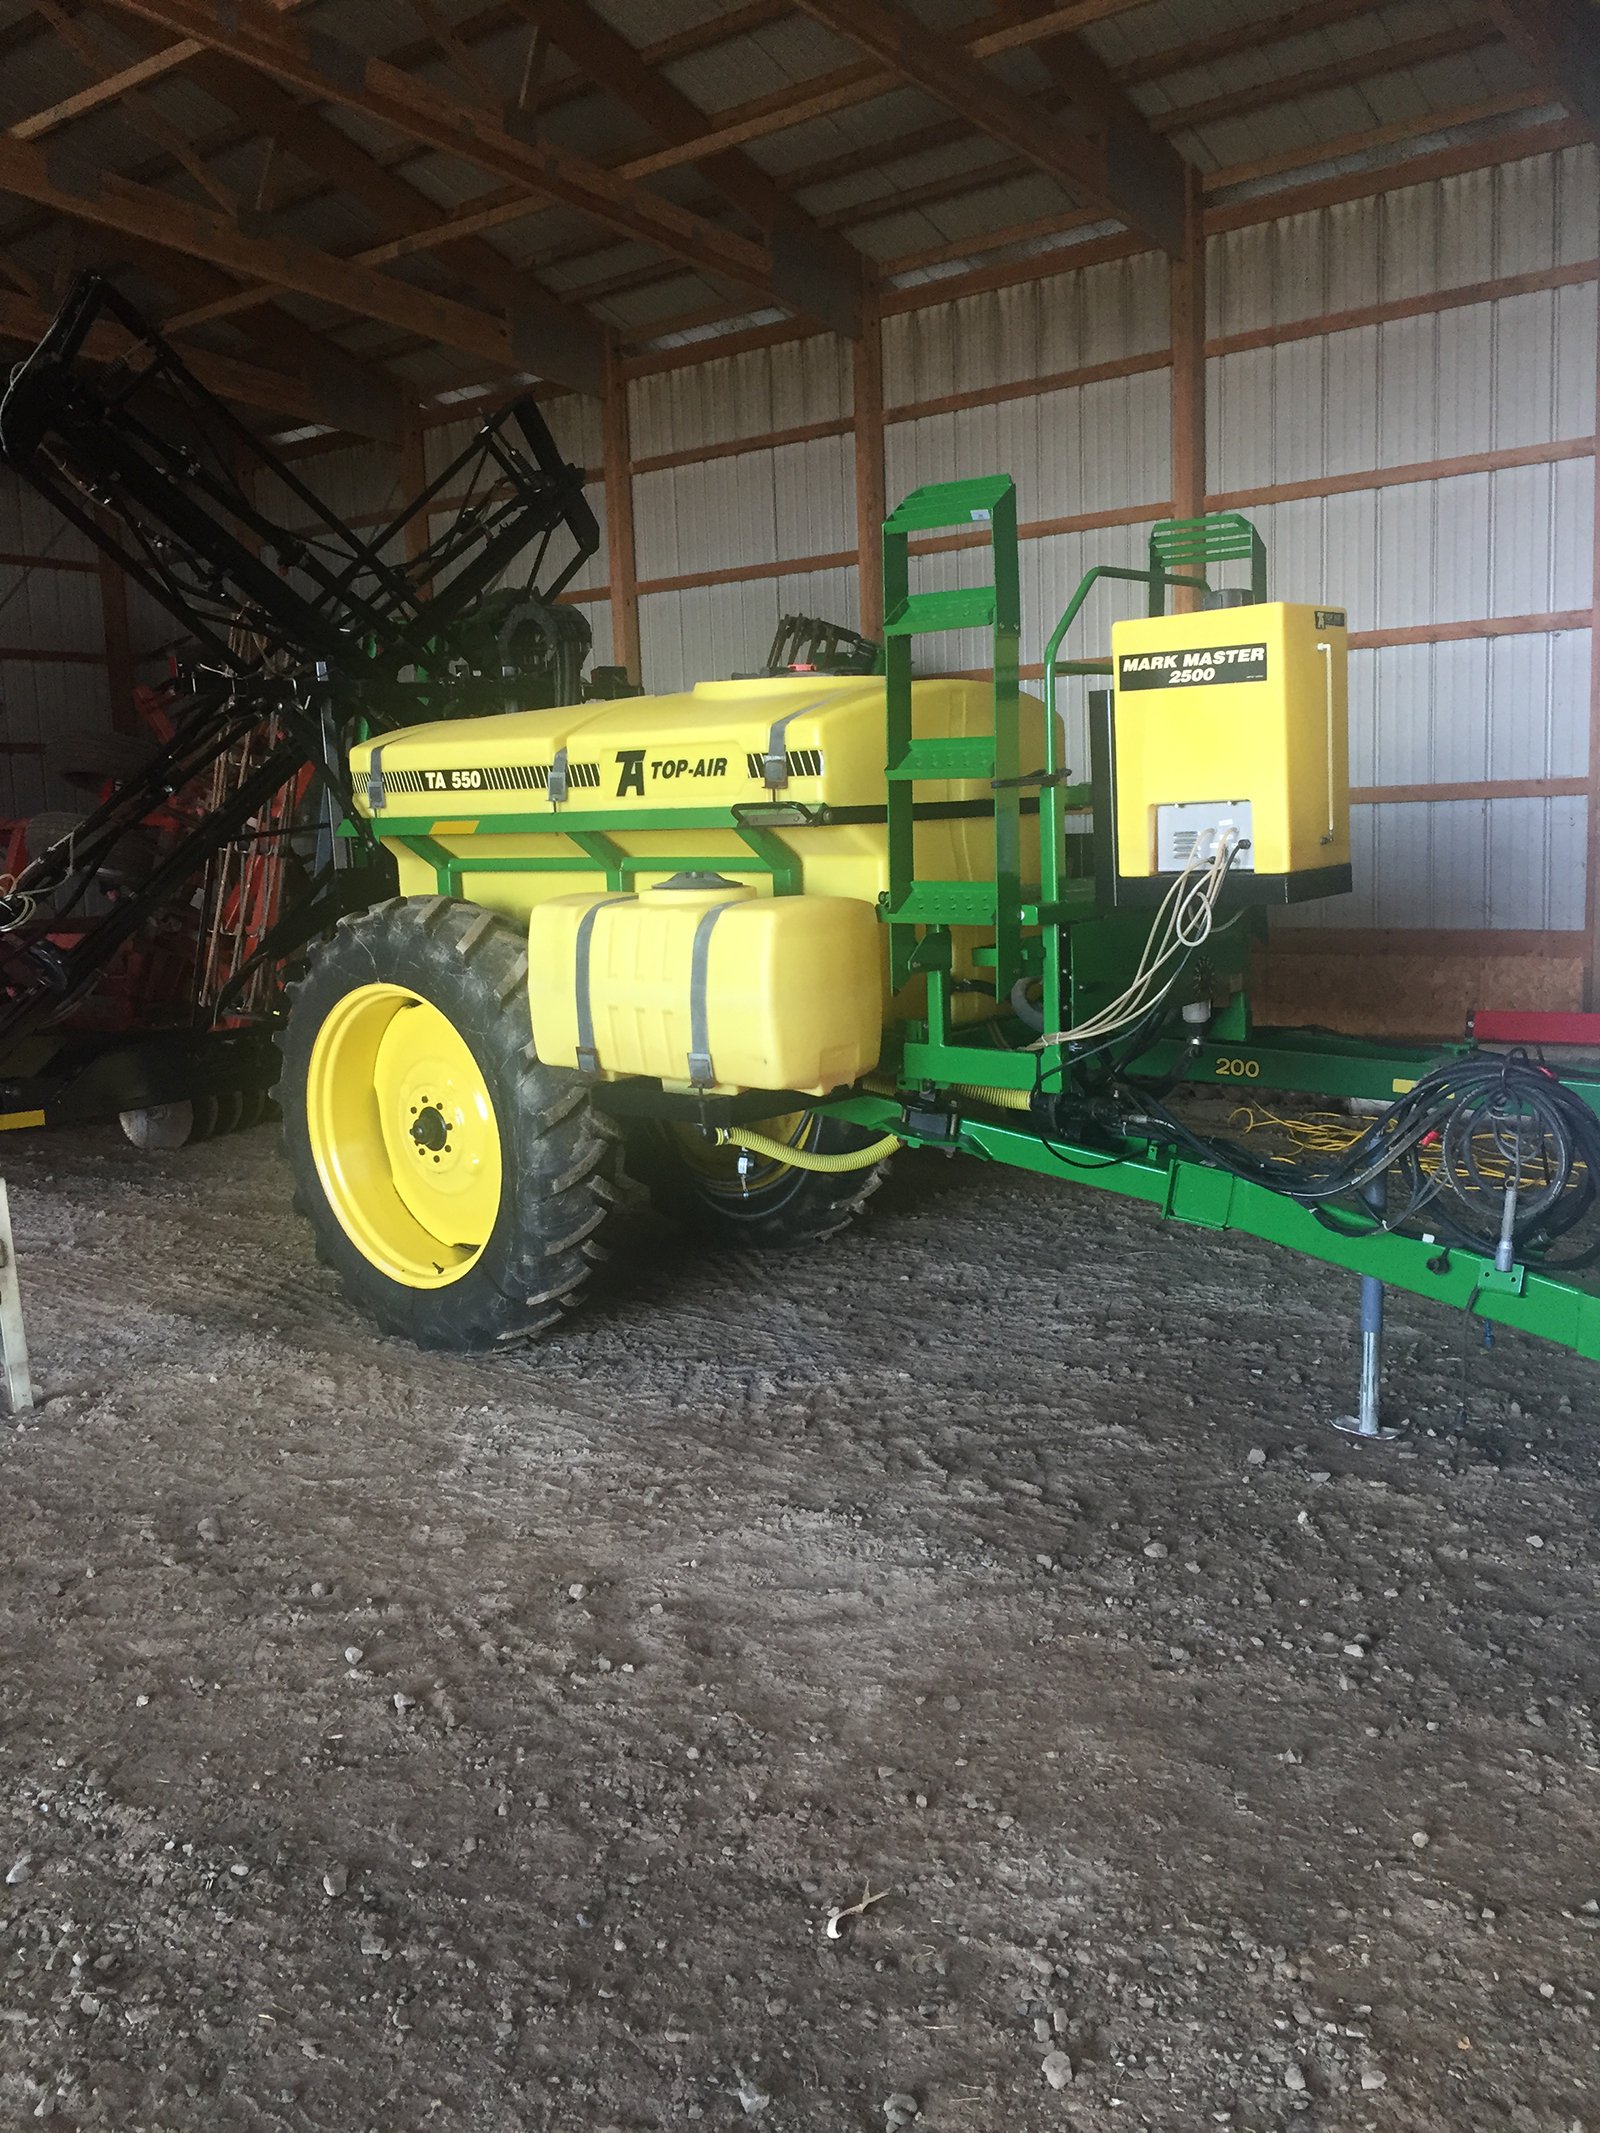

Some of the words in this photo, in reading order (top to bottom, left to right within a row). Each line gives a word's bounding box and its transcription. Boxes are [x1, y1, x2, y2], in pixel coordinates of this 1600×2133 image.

[1122, 654, 1179, 672] MARK
[1183, 647, 1265, 667] MASTER
[1168, 668, 1216, 684] 2500
[651, 757, 728, 779] TOP-AIR
[424, 771, 447, 789] TA
[451, 770, 481, 789] 550
[1215, 1057, 1260, 1078] 200
